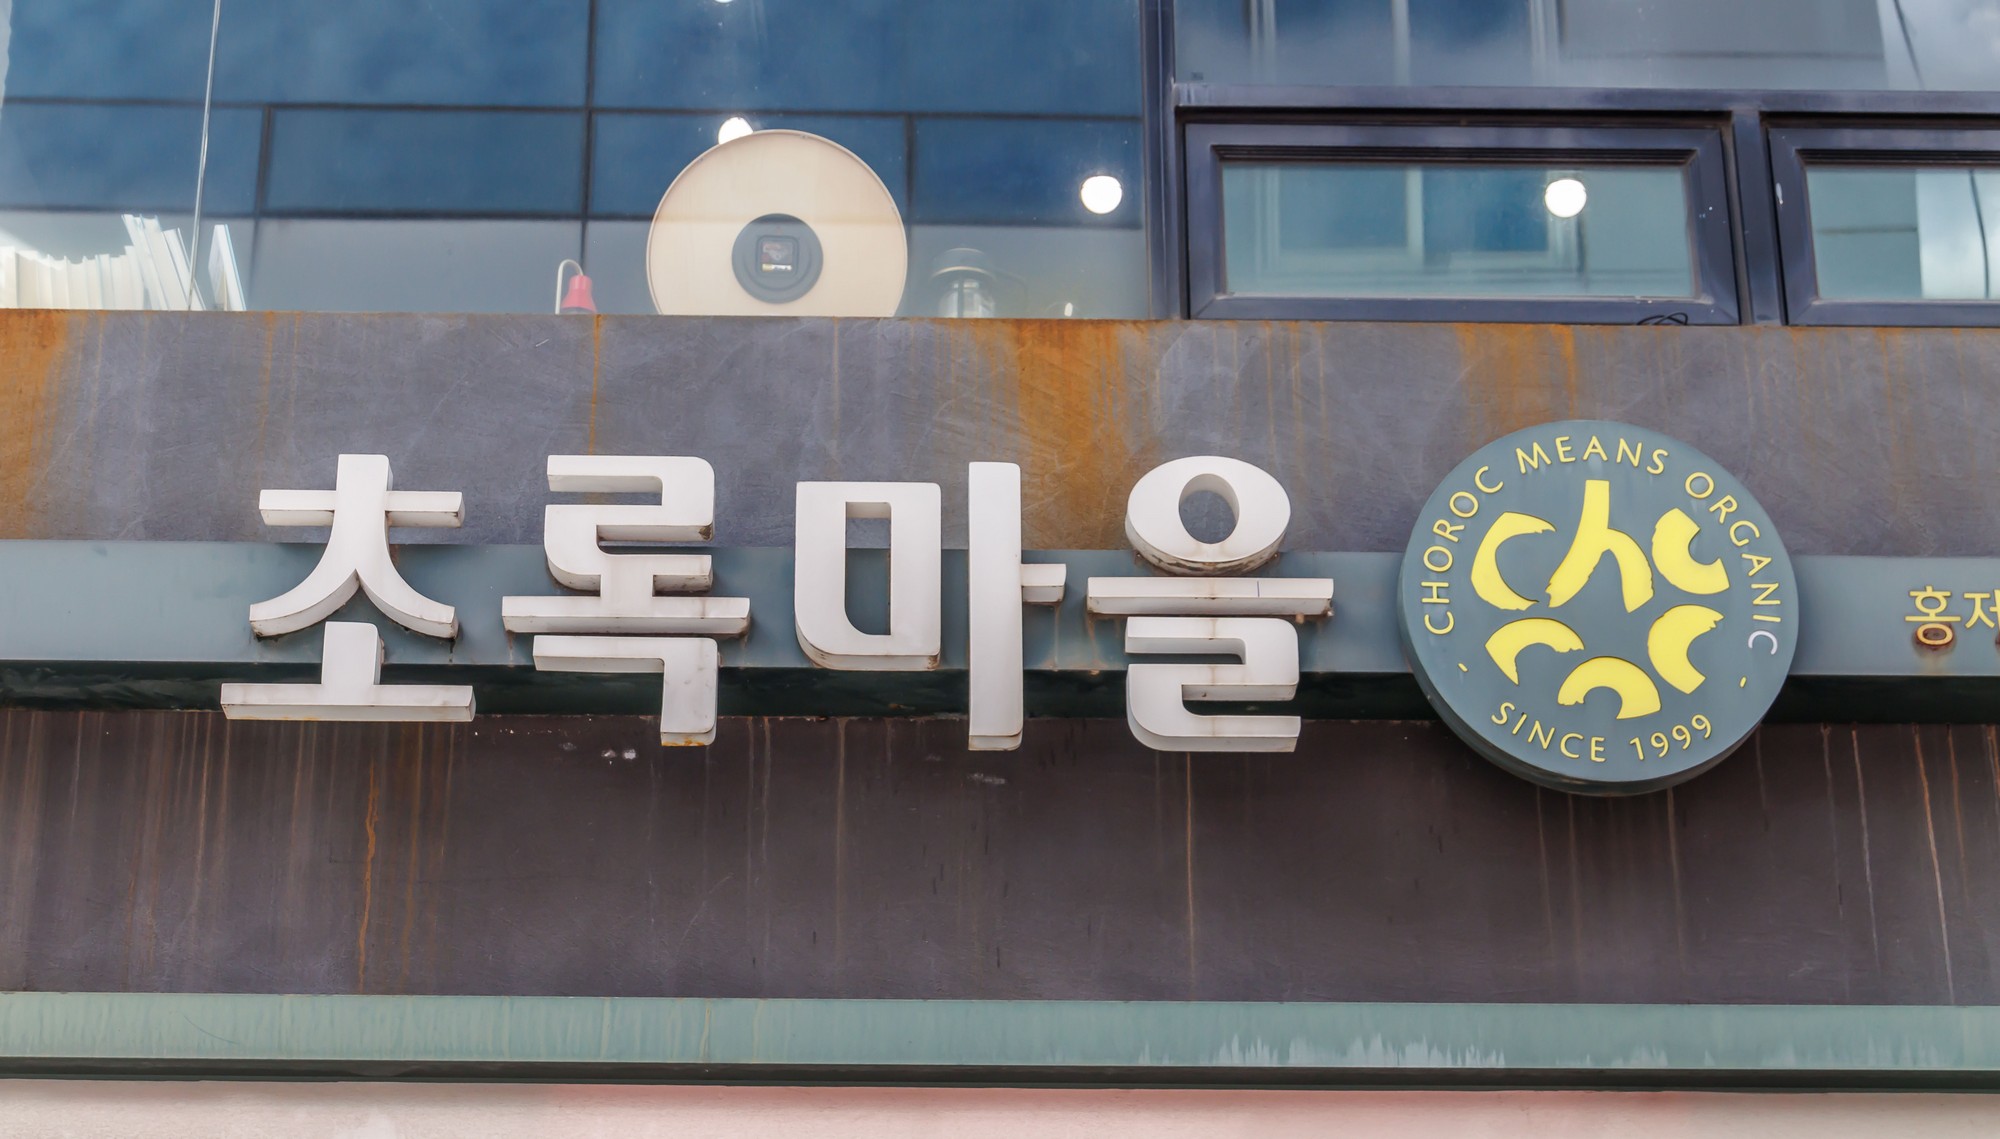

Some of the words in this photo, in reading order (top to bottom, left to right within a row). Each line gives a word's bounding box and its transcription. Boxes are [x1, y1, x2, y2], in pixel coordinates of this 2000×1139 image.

[221, 454, 1334, 752] 초록마을
[1421, 466, 1503, 635] CHOROC
[1516, 435, 1669, 475] MEANS
[1685, 472, 1781, 655] ORGANIC
[1491, 702, 1606, 762] SINCE
[1629, 714, 1713, 760] 1999
